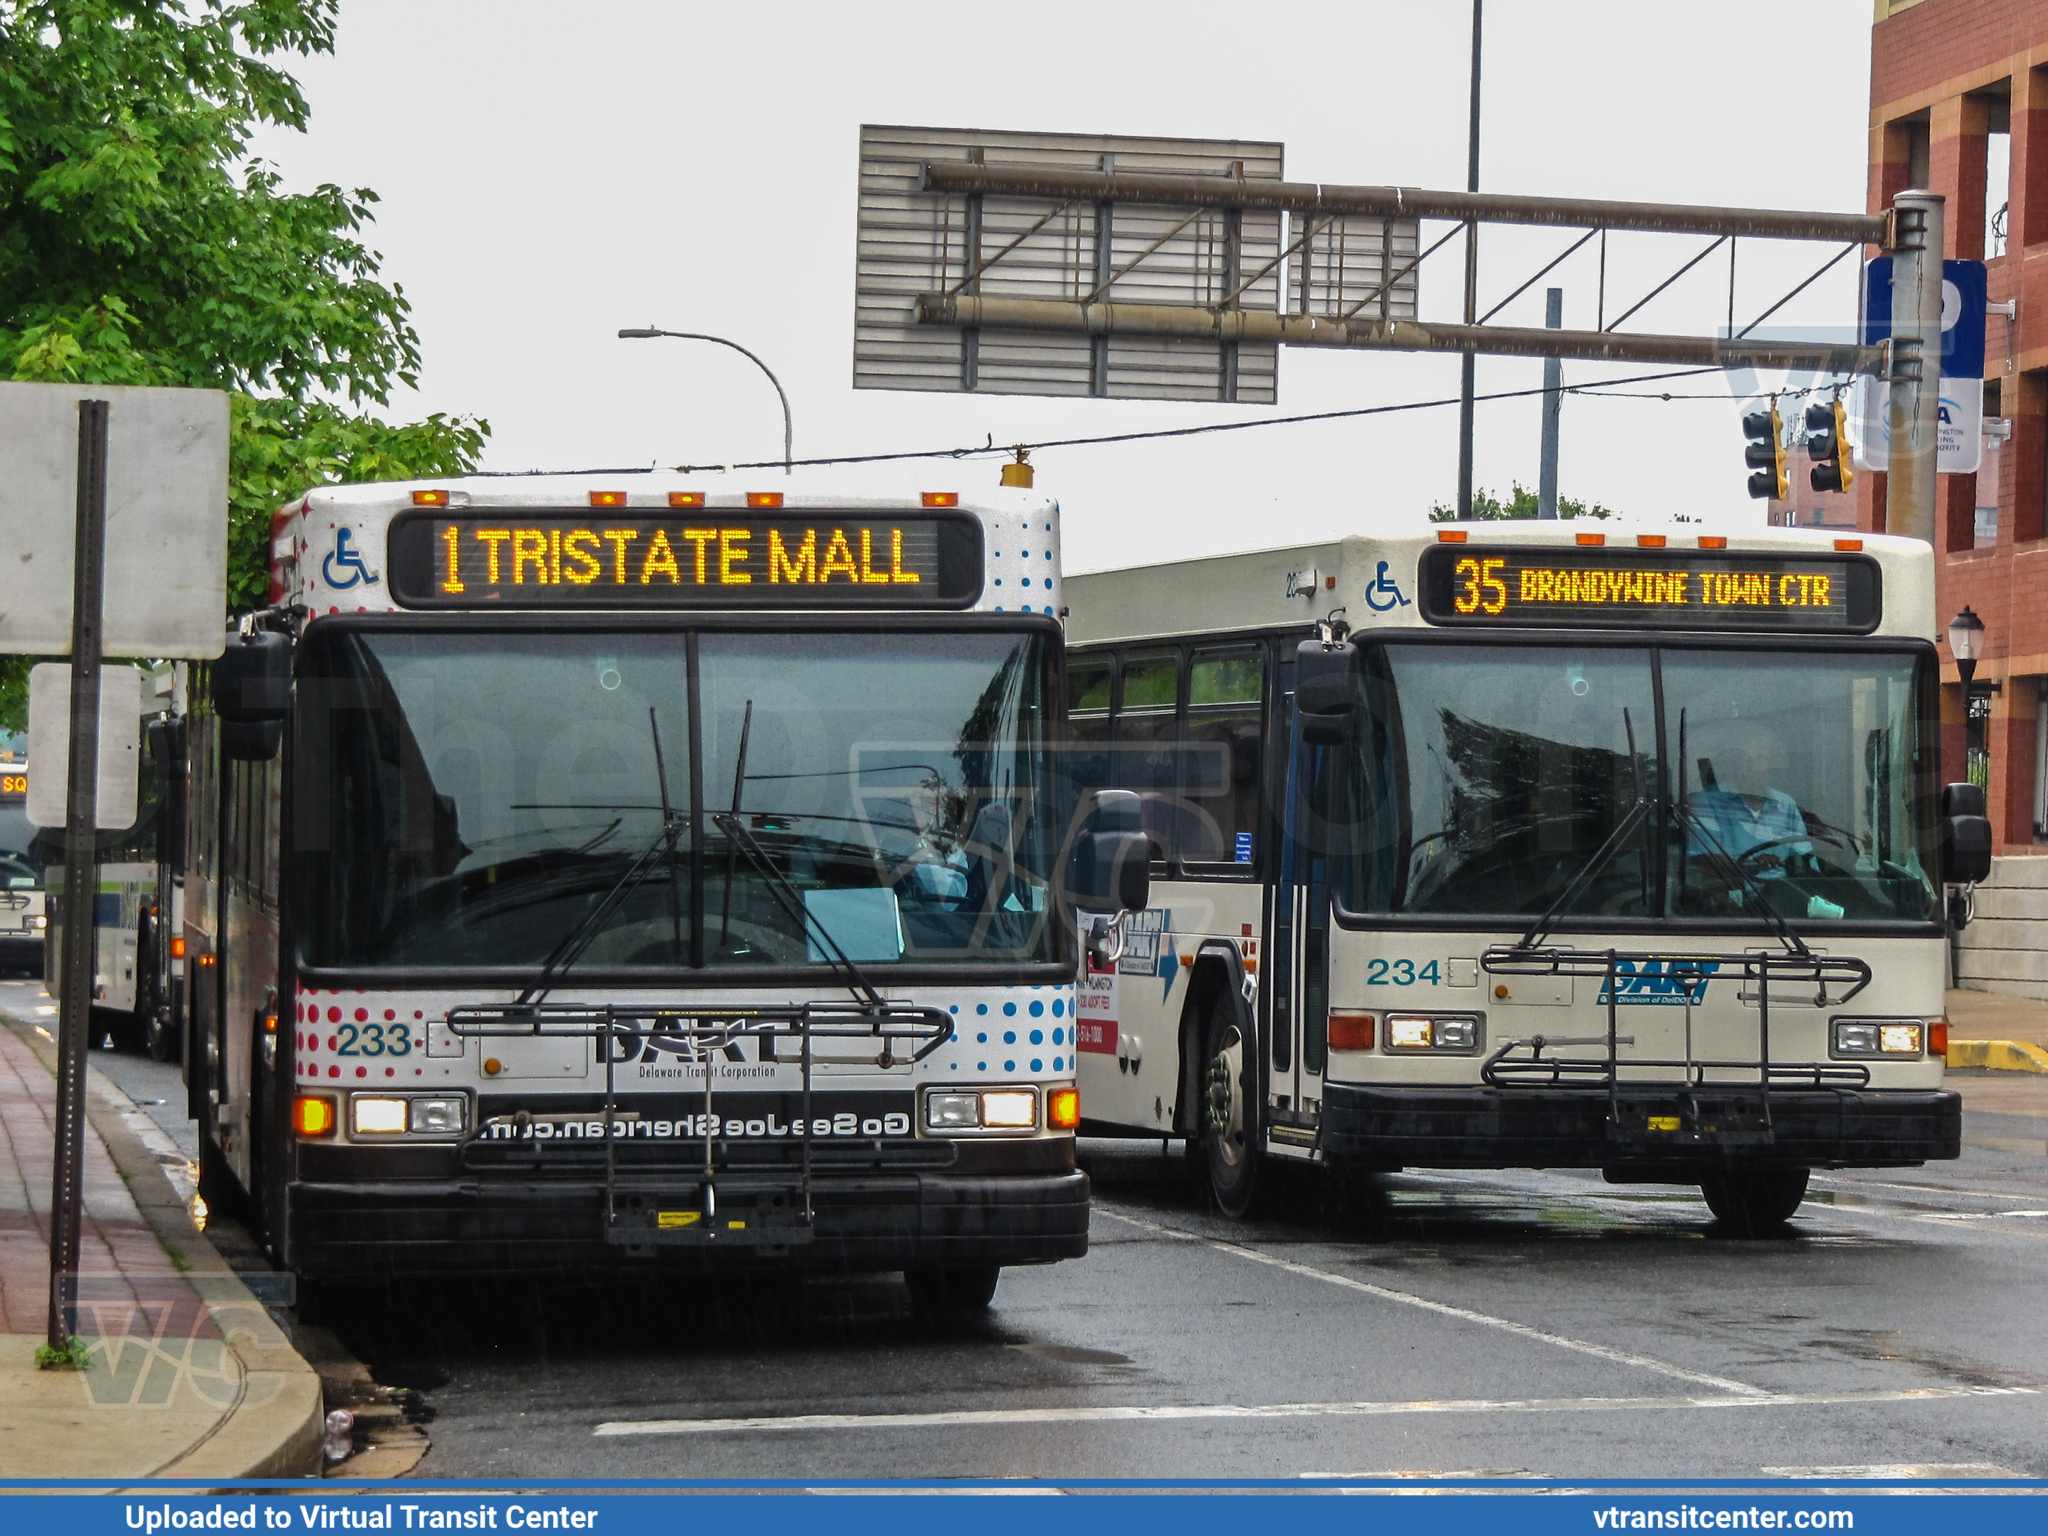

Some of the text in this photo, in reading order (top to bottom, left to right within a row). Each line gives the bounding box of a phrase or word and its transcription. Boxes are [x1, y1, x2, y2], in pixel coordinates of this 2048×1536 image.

[442, 525, 920, 594] 1 TRISTATE MALL
[1455, 558, 1830, 615] 35 BRANDYWINE TOWN CTR
[2, 776, 27, 792] SQ
[1367, 958, 1442, 986] 234
[338, 1023, 412, 1056] 233
[639, 1065, 776, 1080] Delaware Tranit Corporation
